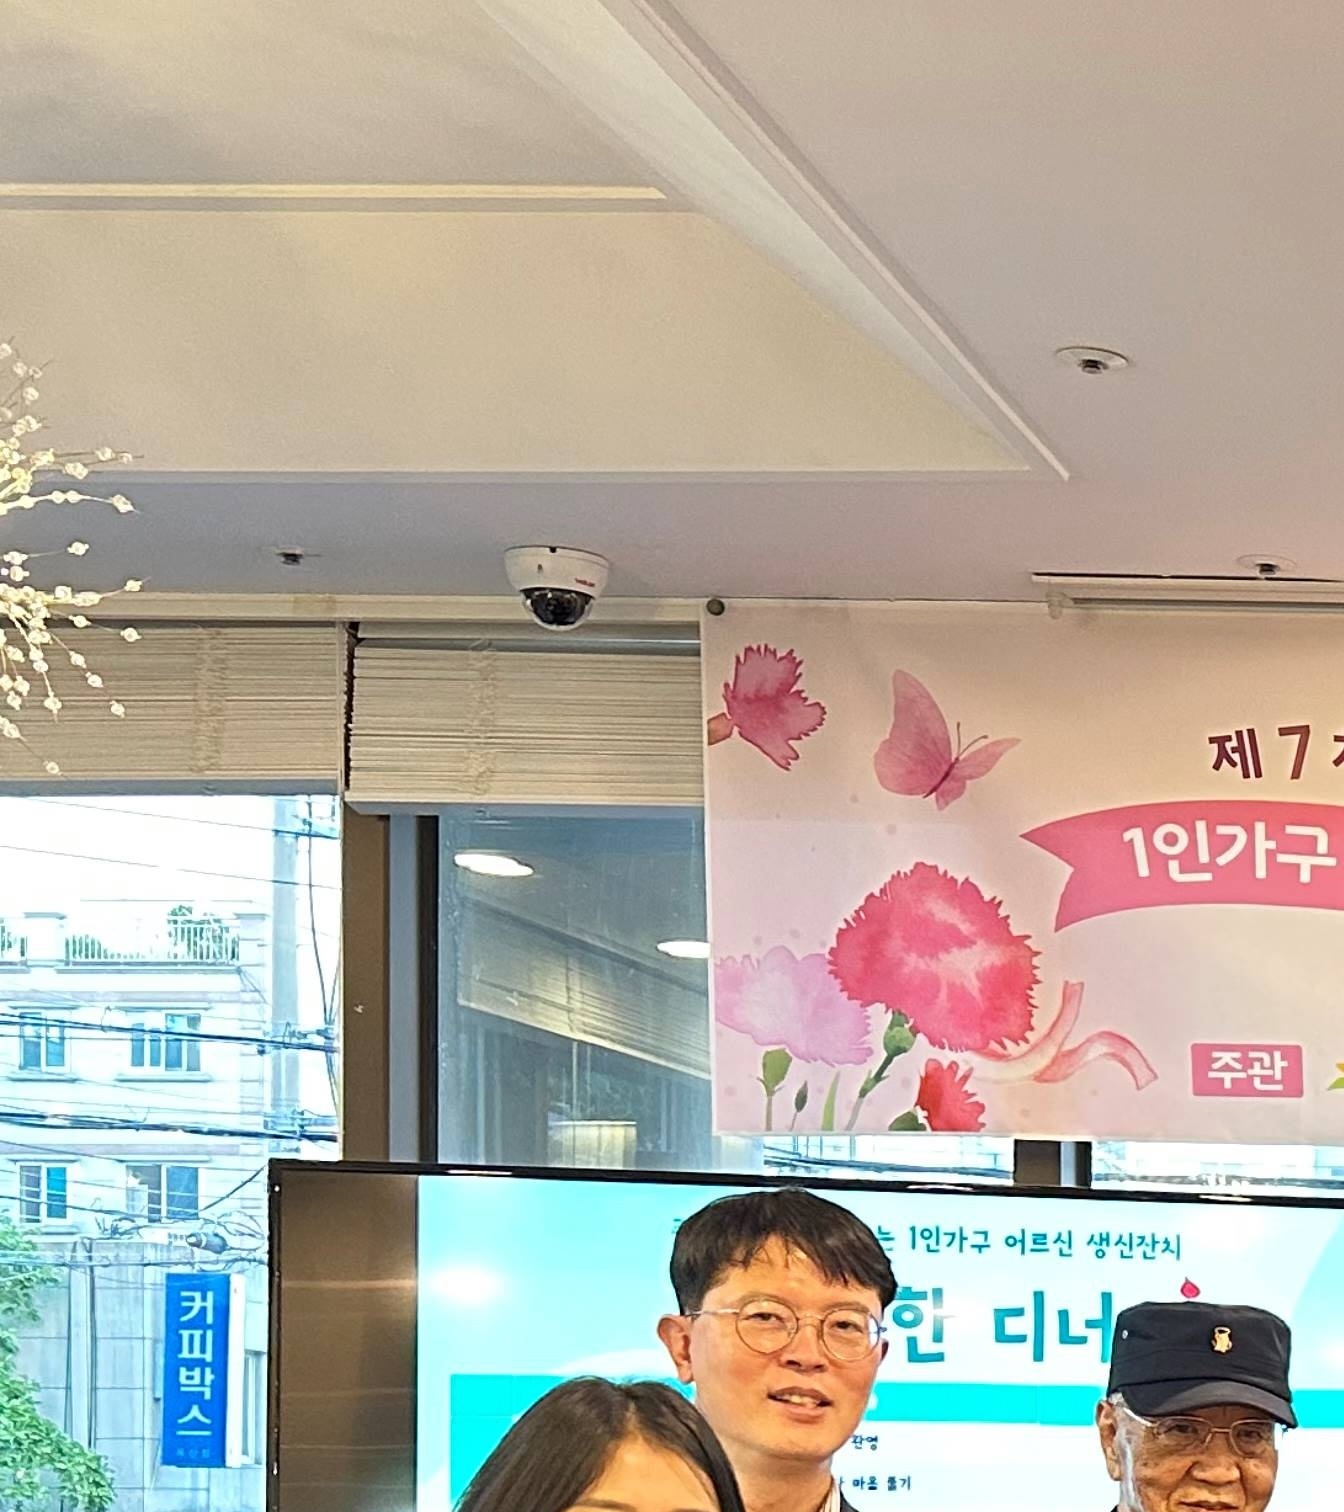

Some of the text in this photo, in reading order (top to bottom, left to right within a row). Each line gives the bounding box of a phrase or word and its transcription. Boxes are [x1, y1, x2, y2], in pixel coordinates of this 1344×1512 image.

[1207, 727, 1264, 780] 제
[1277, 724, 1312, 781] 7
[1122, 824, 1338, 884] 1인가구
[1207, 1049, 1289, 1093] 주관
[908, 1225, 992, 1254] 1인가구
[1003, 1228, 1073, 1257] 어르신
[1086, 1232, 1181, 1261] 생신잔치
[993, 1290, 1113, 1364] 디너
[175, 1290, 216, 1437] 커피박스
